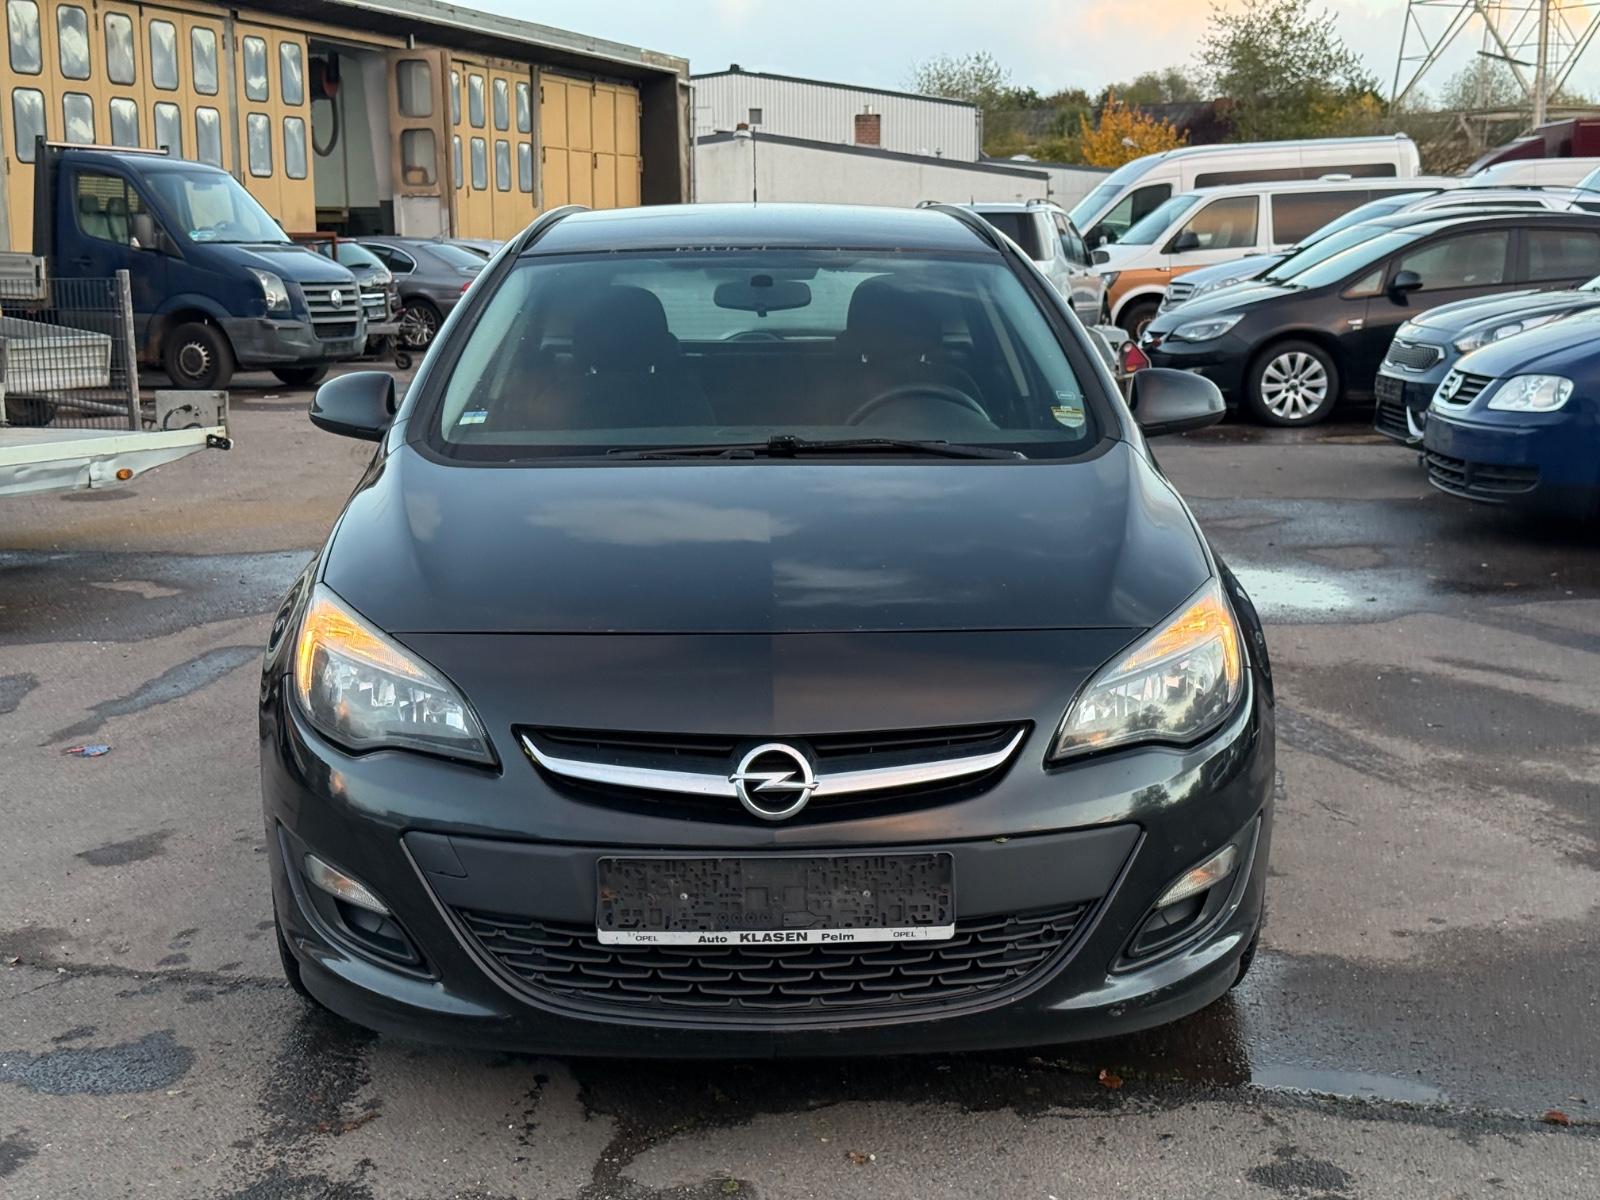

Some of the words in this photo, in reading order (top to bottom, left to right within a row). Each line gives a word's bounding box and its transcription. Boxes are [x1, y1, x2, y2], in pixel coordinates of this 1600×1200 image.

[697, 935, 728, 943] Auto
[739, 932, 808, 943] KLASEN
[821, 932, 855, 941] Pelm
